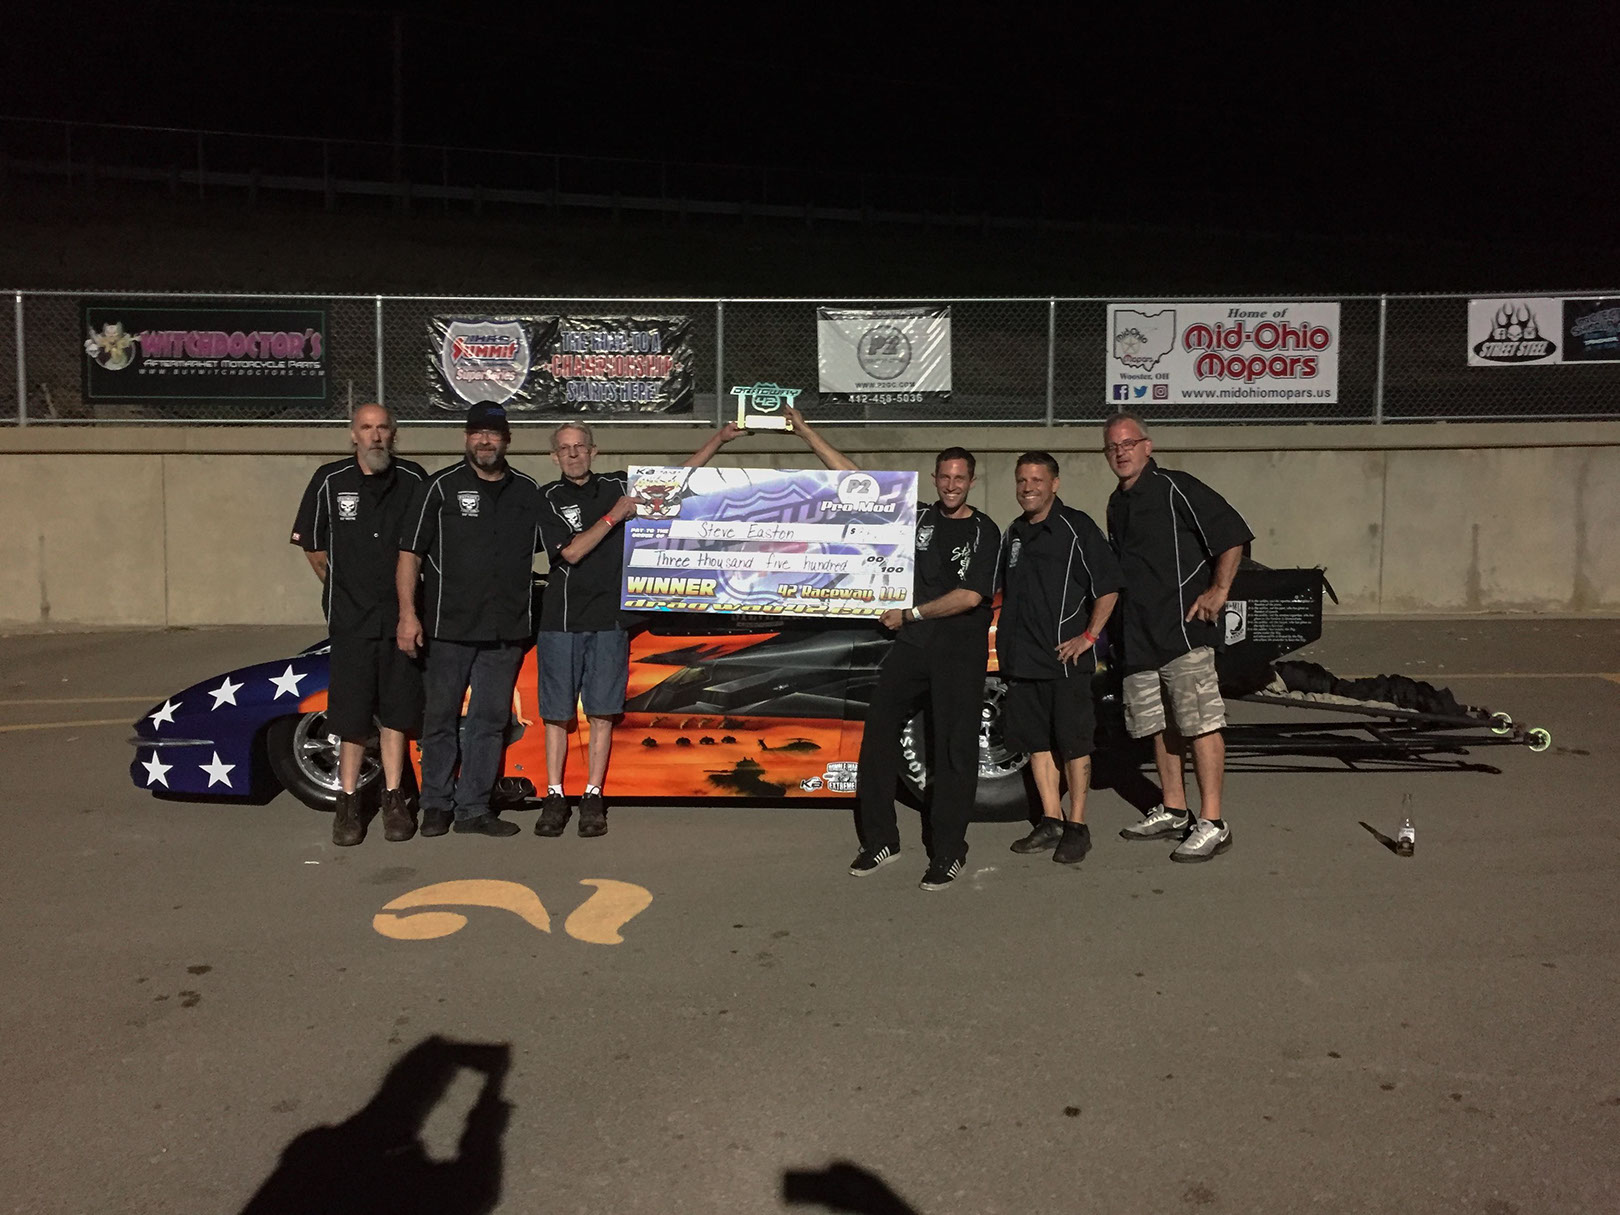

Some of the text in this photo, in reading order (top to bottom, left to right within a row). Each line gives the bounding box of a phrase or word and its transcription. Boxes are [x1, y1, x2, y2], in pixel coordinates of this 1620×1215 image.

[1227, 308, 1289, 319] Home of
[560, 331, 585, 352] THE
[631, 331, 650, 352] TO
[650, 331, 661, 352] A
[1182, 320, 1332, 353] Mid-Ohio
[1478, 340, 1549, 358] STREET STEEL
[551, 354, 673, 378] CHAMPIONSHIP
[1193, 351, 1318, 384] Mopars
[566, 381, 617, 402] STARTS
[1182, 387, 1332, 401] www.midohiomopars.us
[755, 397, 778, 407] 42
[846, 479, 872, 494] P2
[821, 500, 897, 514] Pro Mod
[698, 521, 796, 540] Steve Easton
[654, 551, 691, 567] Three
[803, 556, 849, 572] hundred
[627, 576, 718, 597] WINNER
[777, 584, 798, 597] 42
[879, 586, 908, 602] LLC
